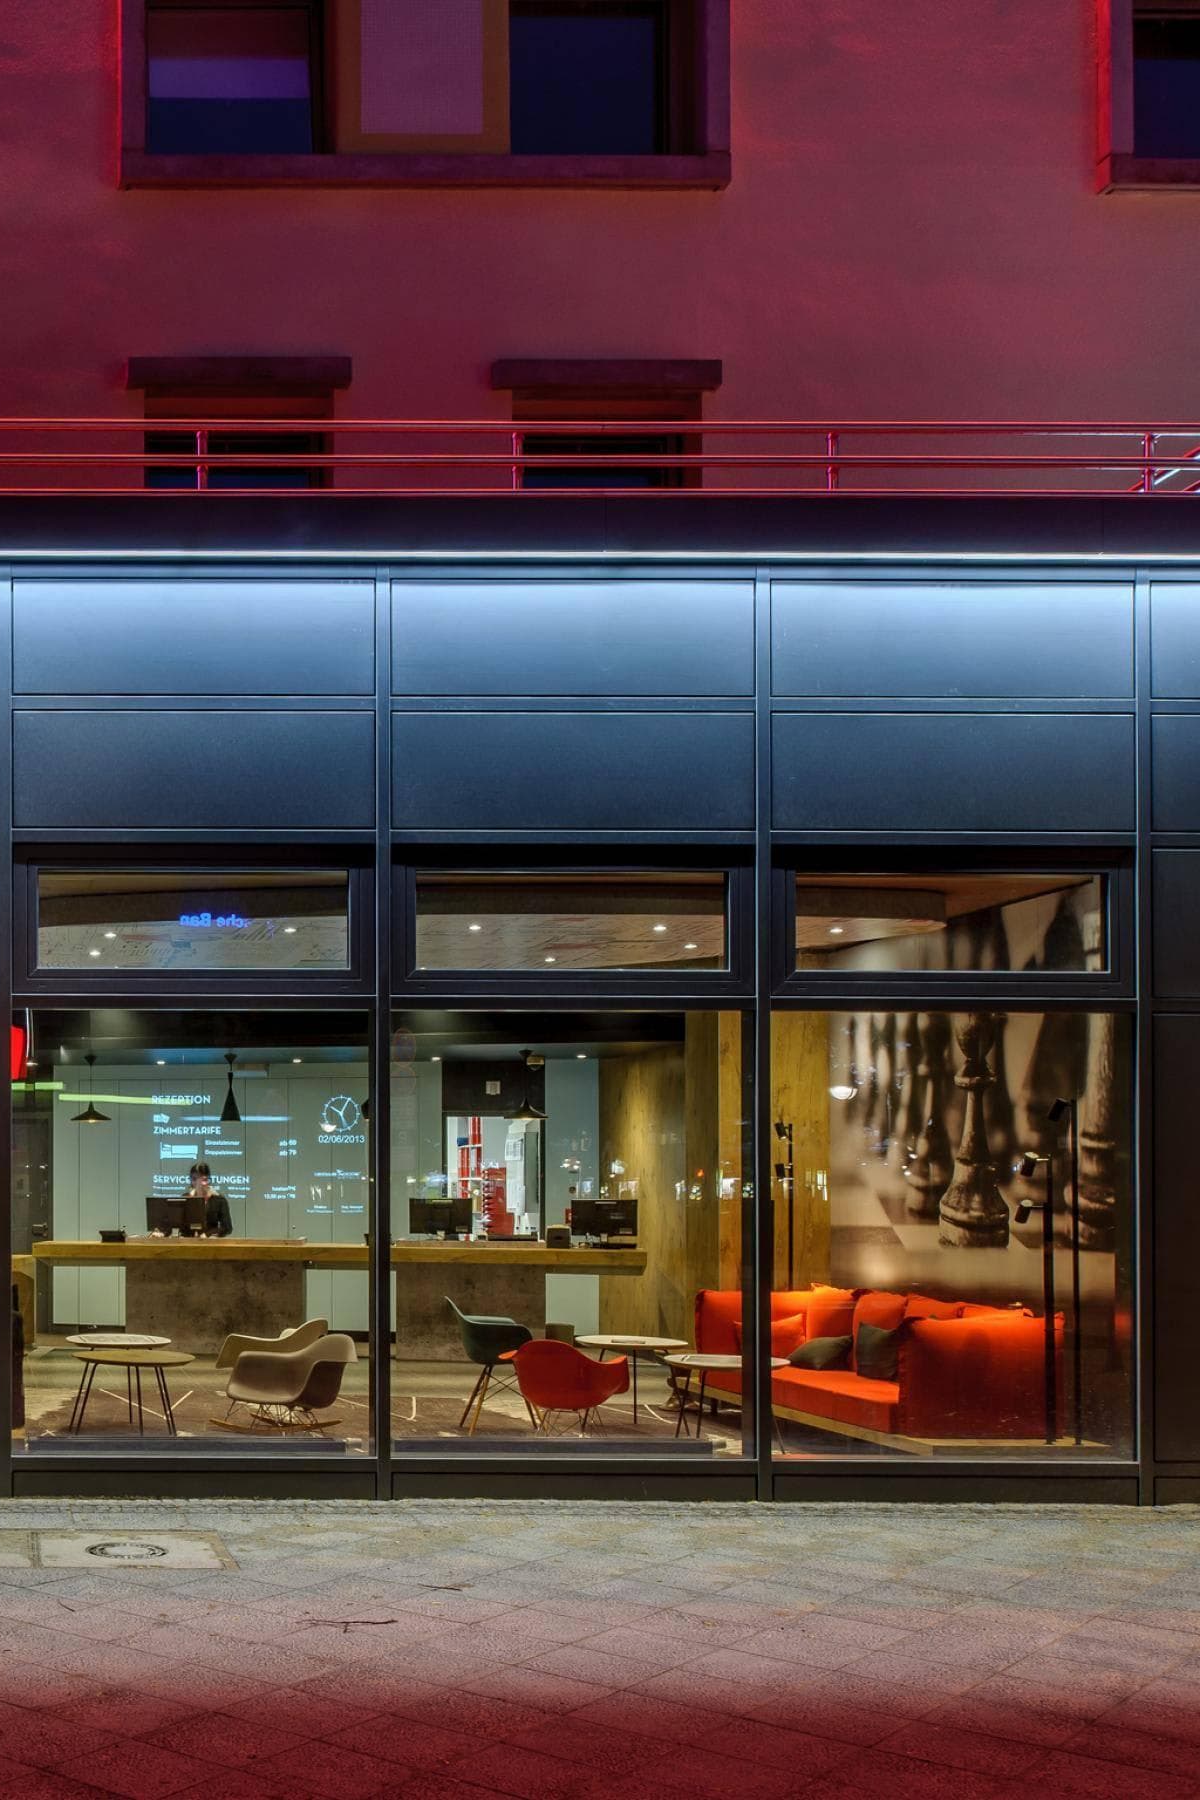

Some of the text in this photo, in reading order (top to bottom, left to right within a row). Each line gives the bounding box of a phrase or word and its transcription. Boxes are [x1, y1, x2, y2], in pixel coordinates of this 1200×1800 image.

[151, 1095, 211, 1105] REZEPTION
[153, 1126, 222, 1135] ZIMMERTARIFE
[318, 1134, 365, 1144] 02/06/2013
